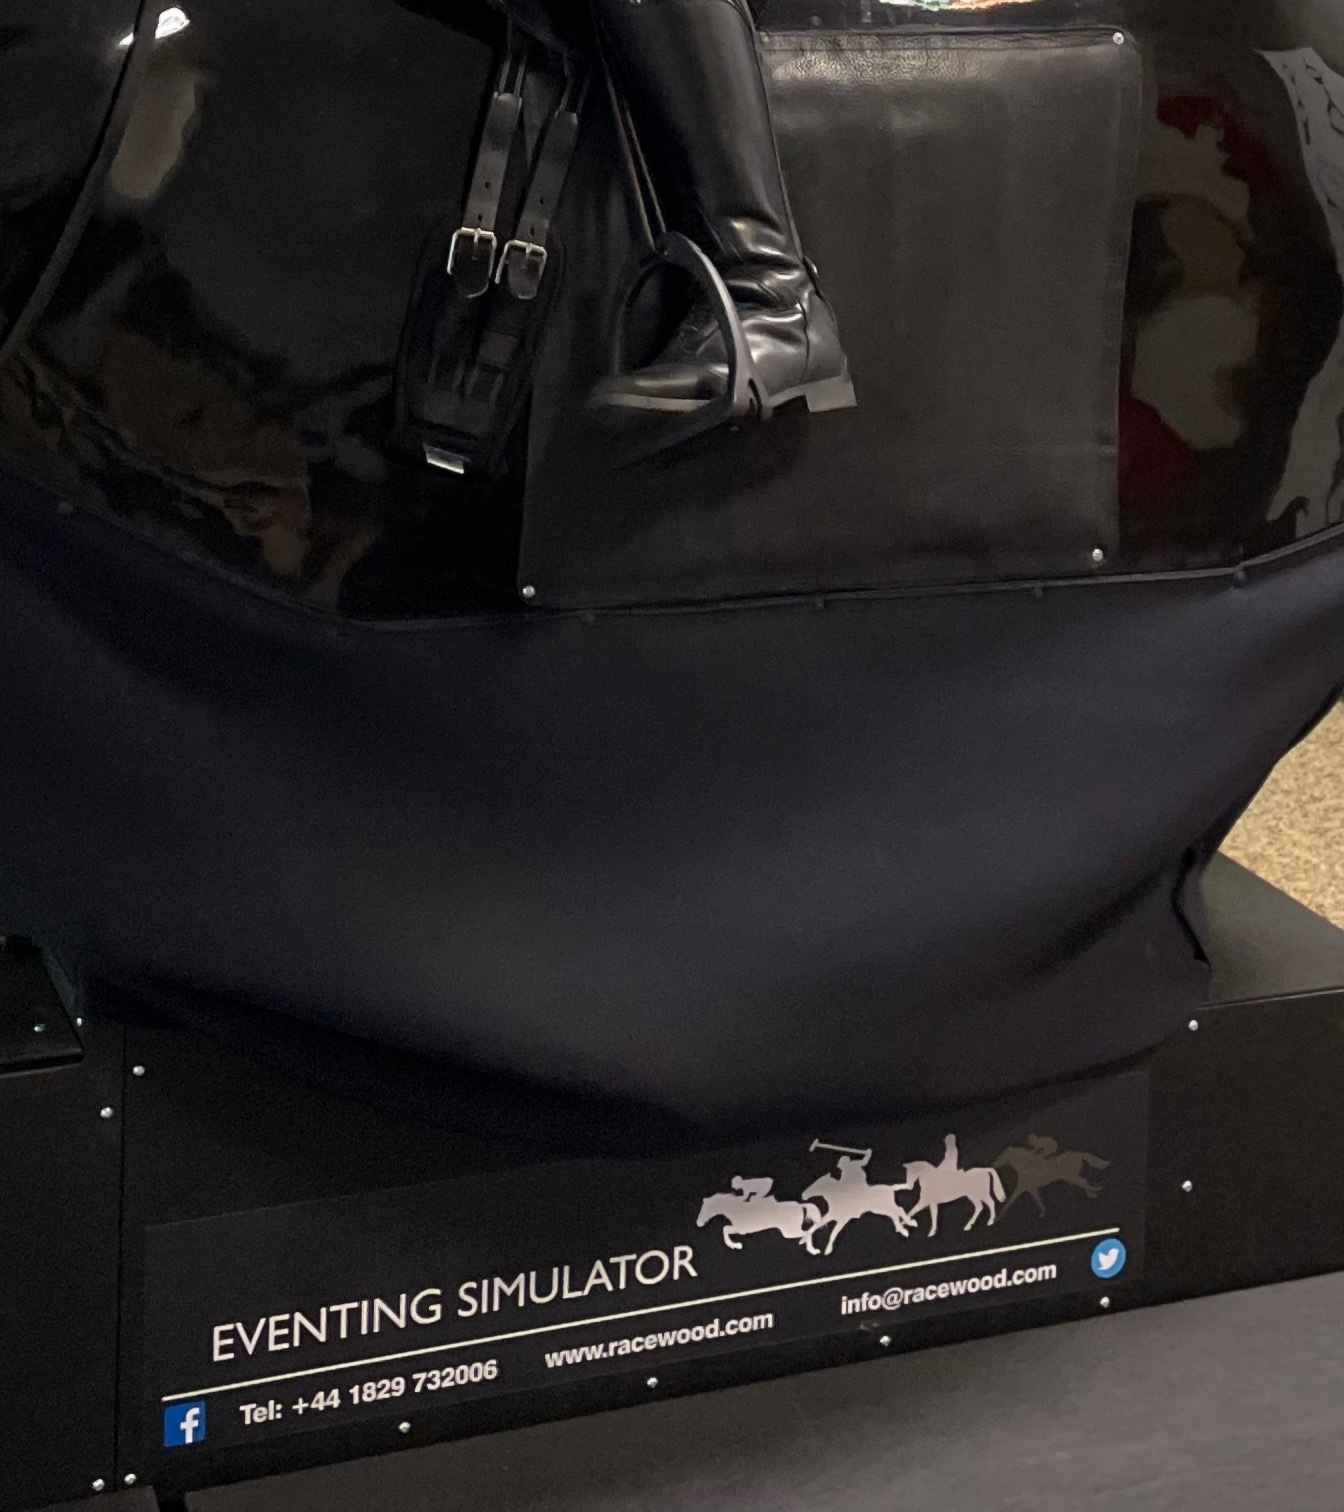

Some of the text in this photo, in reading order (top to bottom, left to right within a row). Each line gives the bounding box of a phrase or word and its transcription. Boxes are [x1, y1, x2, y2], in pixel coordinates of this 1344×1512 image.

[211, 1244, 699, 1363] EVENTING SIMULATOR
[840, 1260, 1058, 1317] info@racewood.com
[544, 1310, 775, 1369] www.racewood.com
[239, 1358, 499, 1426] Tel: +44 1829 732006
